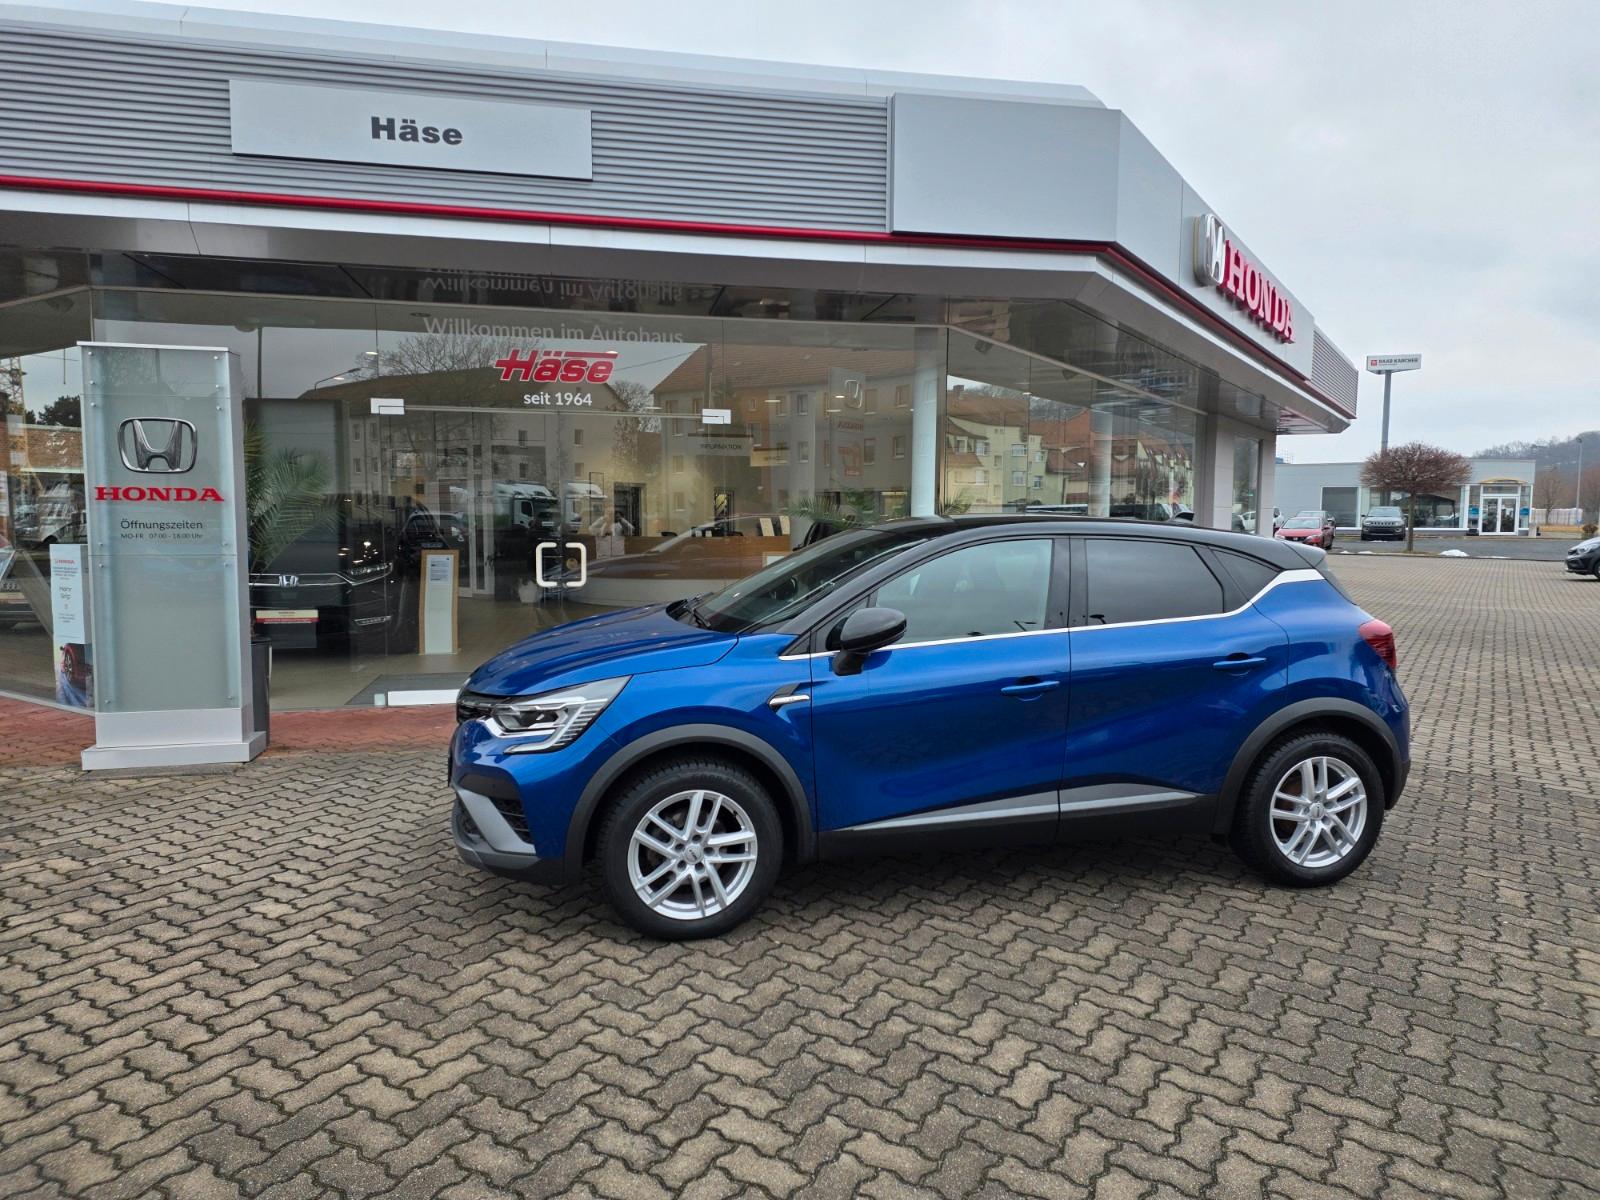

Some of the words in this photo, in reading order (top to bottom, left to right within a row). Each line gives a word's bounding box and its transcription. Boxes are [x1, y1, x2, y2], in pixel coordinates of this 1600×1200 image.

[371, 116, 463, 145] Häse
[1217, 240, 1294, 344] HONDA
[423, 317, 554, 338] Willkommen
[561, 323, 584, 338] im
[591, 324, 683, 343] Autohaus
[494, 349, 618, 384] Häse
[524, 393, 550, 405] seit
[555, 392, 592, 406] 1964
[95, 486, 224, 502] HONDA
[120, 518, 203, 531] Öffnungszeiten
